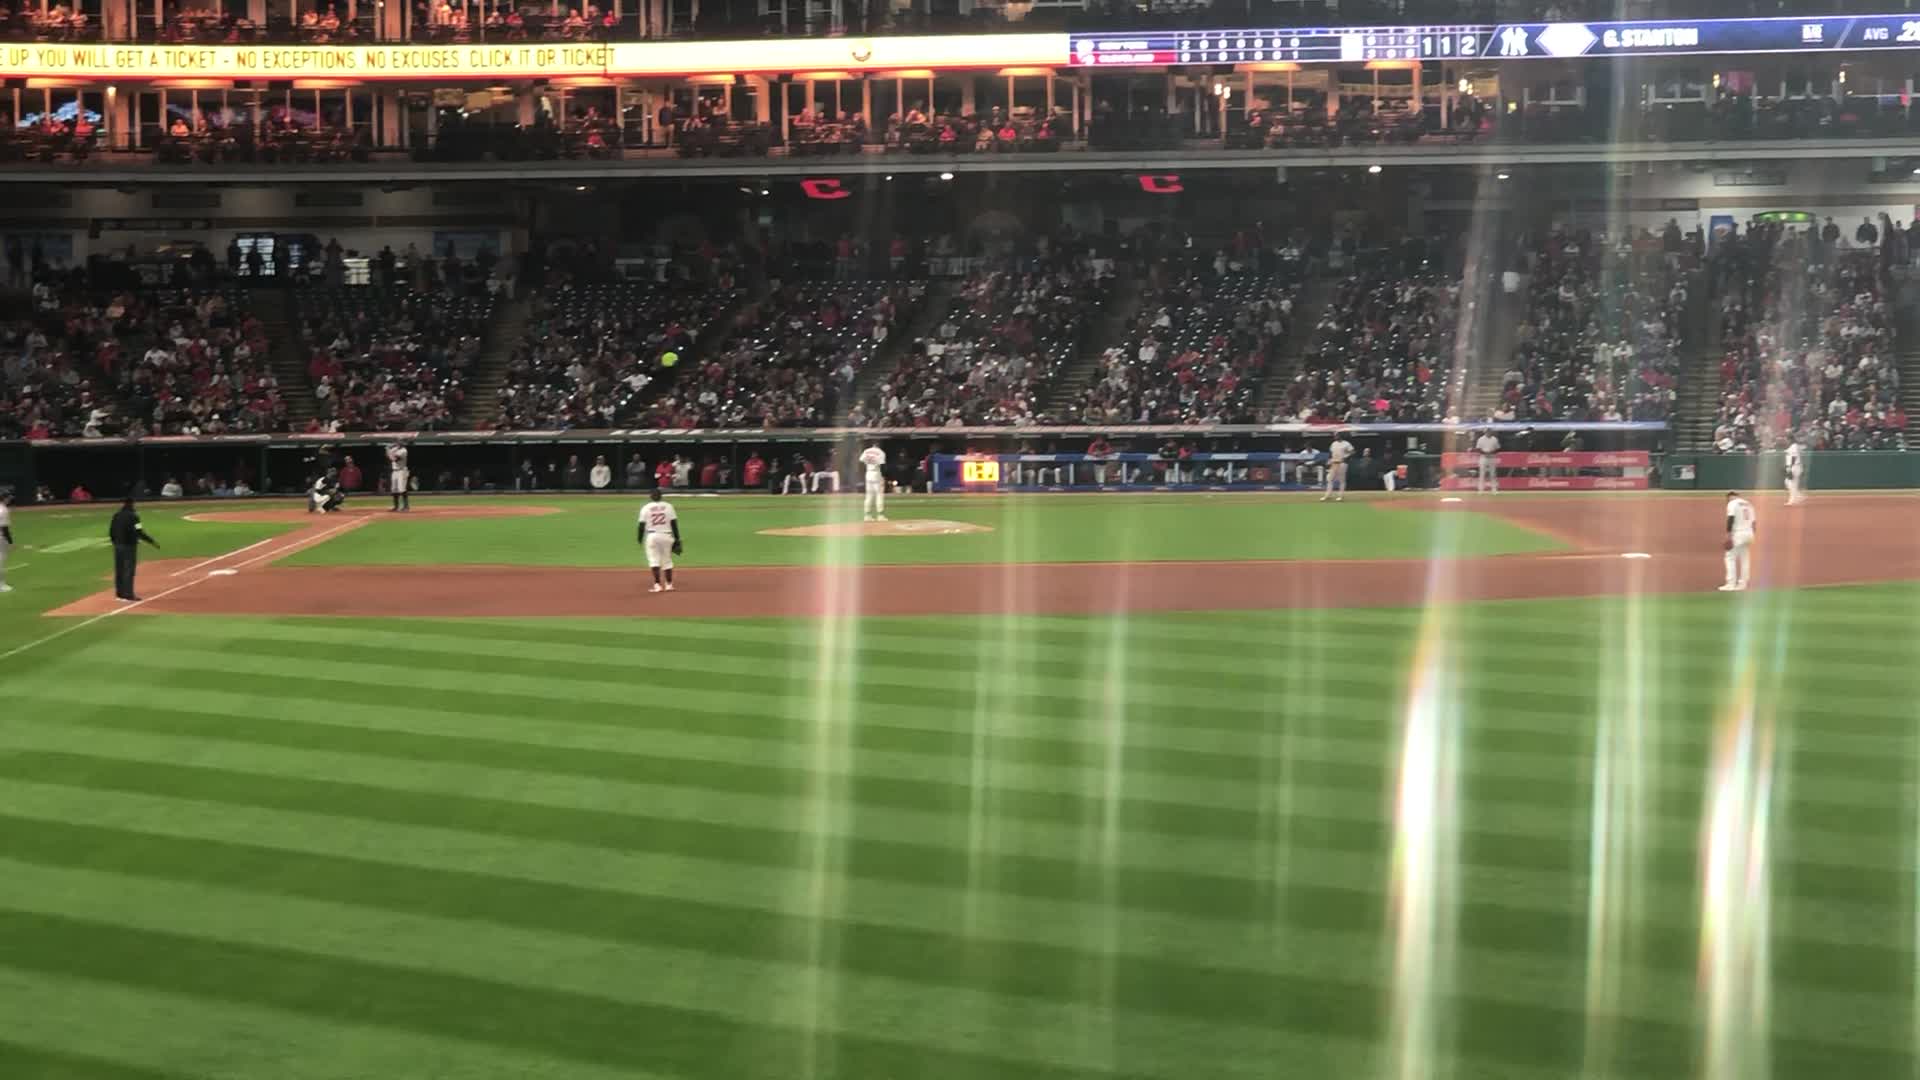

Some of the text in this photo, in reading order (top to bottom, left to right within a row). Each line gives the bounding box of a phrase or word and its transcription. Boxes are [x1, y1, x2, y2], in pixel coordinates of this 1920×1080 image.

[1864, 28, 1889, 40] AVG
[1422, 36, 1475, 55] 1 1 2
[9, 48, 30, 66] UP
[37, 48, 67, 67] YOU
[73, 49, 111, 68] WILL
[116, 49, 144, 68] GET
[149, 50, 159, 67] A
[163, 50, 216, 69] TICKET
[237, 50, 257, 69] NO
[263, 50, 356, 69] EXCEPTIONS
[366, 50, 387, 69] NO
[392, 50, 460, 68] EXCUSES
[470, 49, 513, 67] CLICK
[520, 48, 531, 66] IT
[536, 48, 557, 67] OR
[562, 47, 616, 67] TICKET
[651, 512, 667, 526] 22
